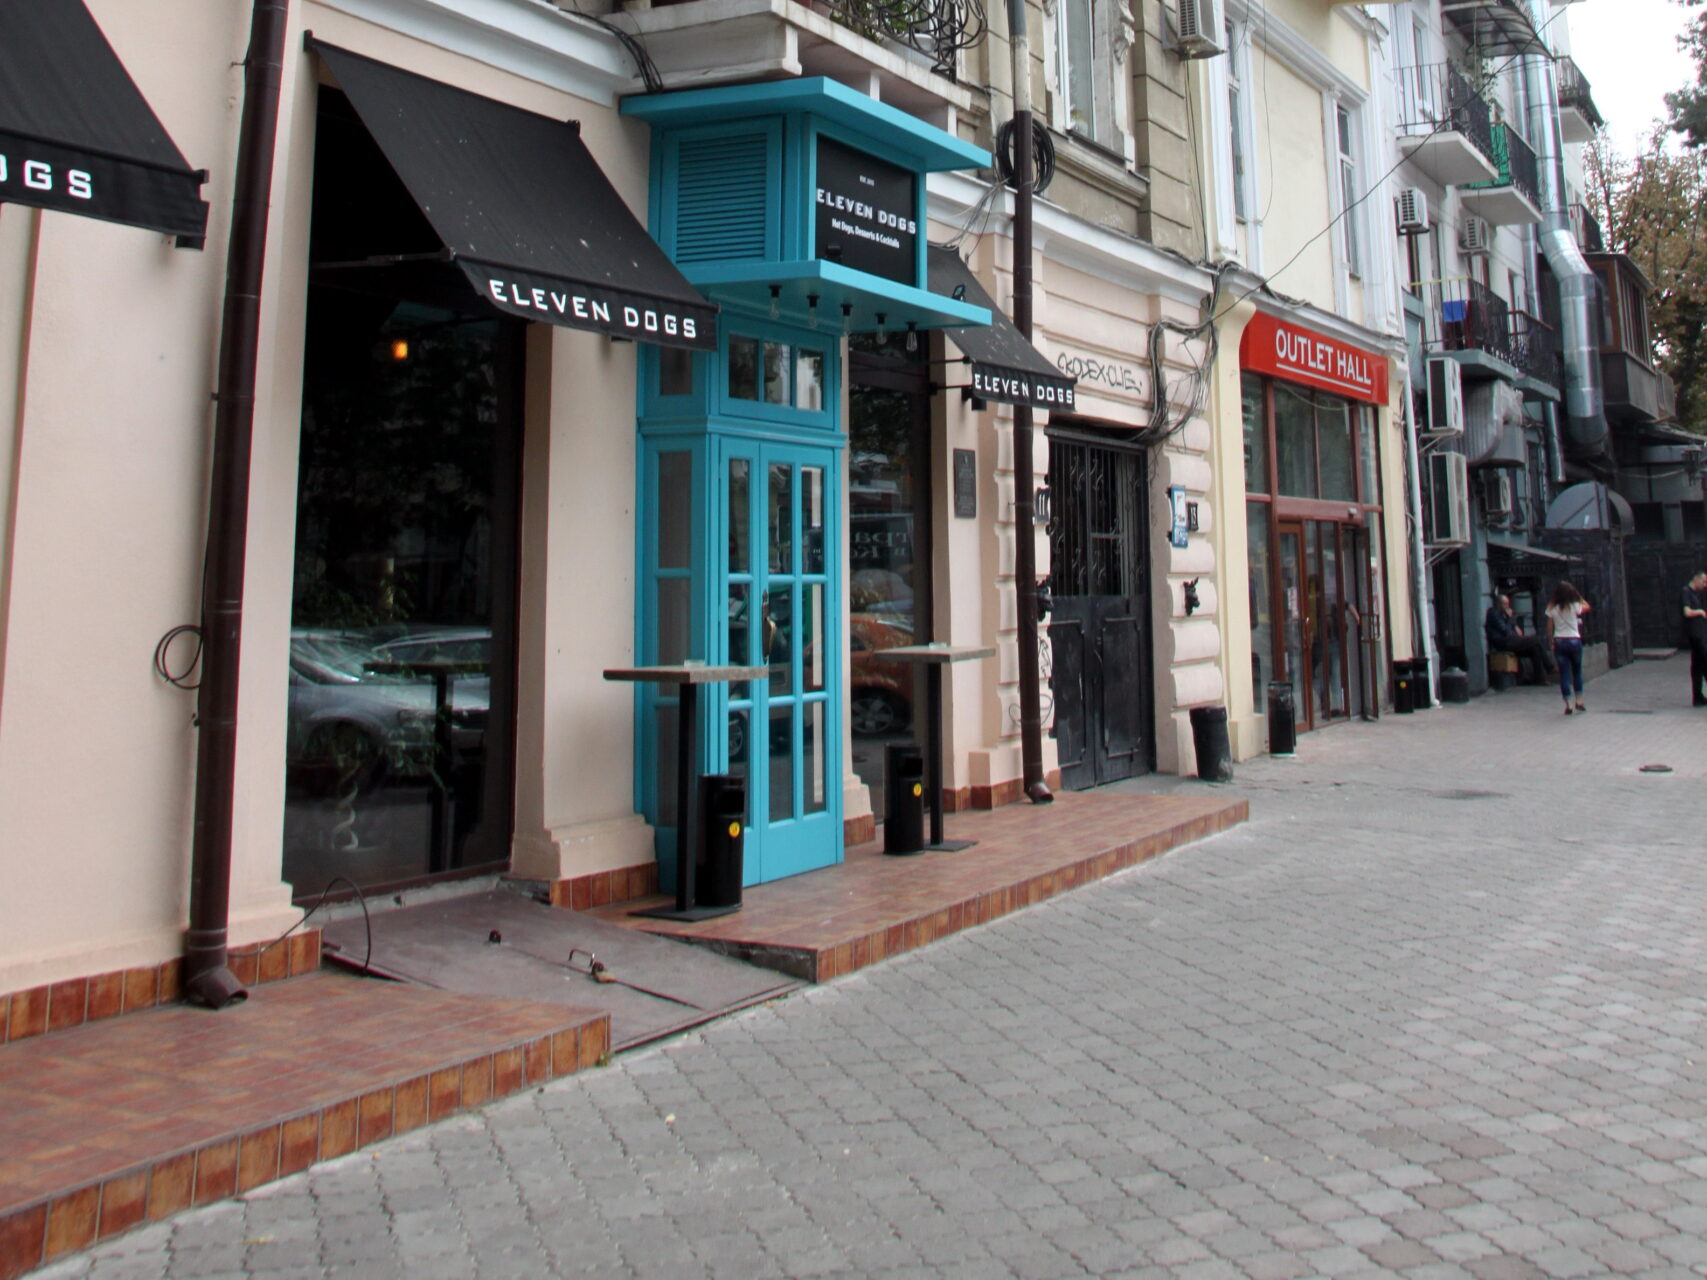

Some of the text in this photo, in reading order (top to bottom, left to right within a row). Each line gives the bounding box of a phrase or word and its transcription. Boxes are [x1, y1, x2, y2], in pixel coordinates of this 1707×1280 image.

[0, 154, 92, 199] GS
[816, 188, 916, 235] ELEVEN DOGS
[489, 279, 697, 339] ELEVEN DOGS
[1275, 328, 1372, 385] OUTLET HALL
[974, 373, 1073, 404] ELEVEN DOGS
